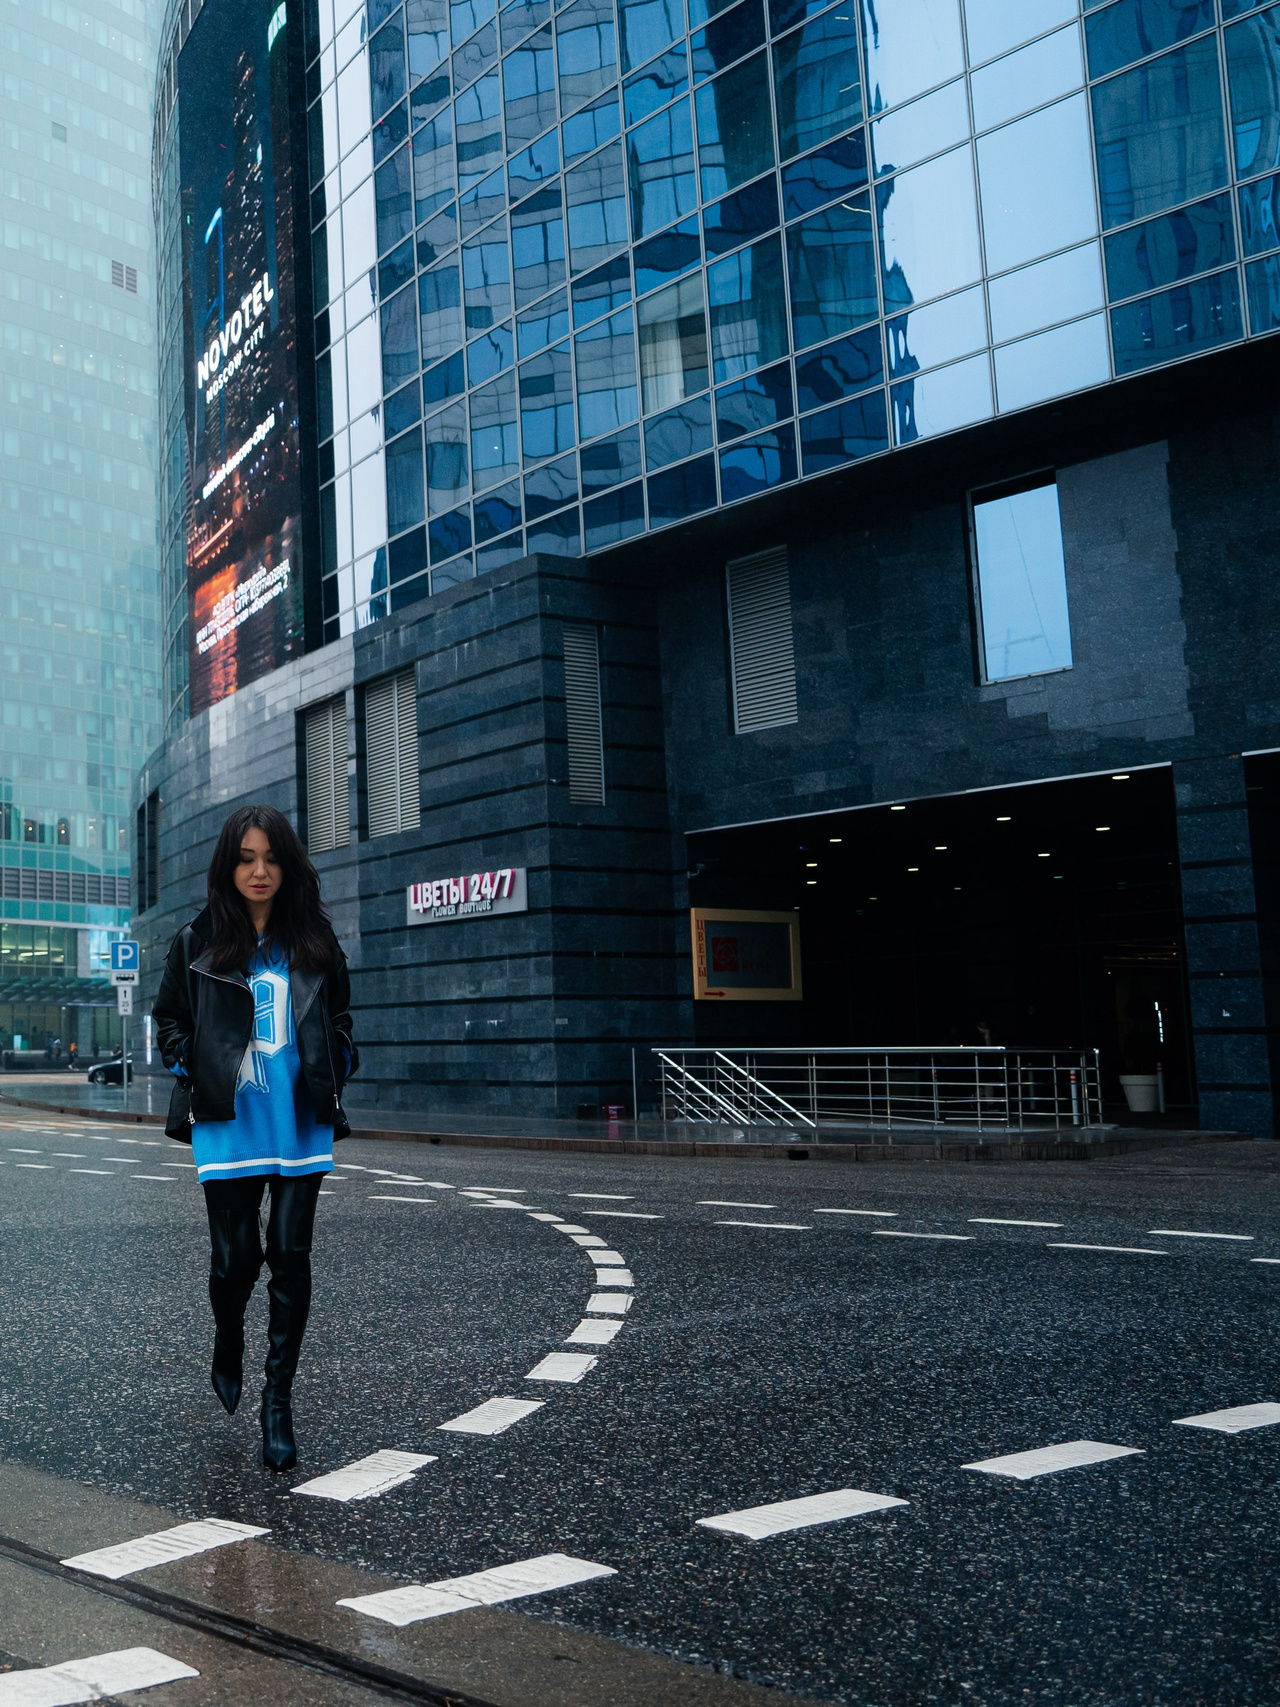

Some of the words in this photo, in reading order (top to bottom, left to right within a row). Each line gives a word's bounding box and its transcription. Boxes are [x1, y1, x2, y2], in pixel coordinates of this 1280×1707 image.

[197, 271, 274, 389] NOVOTEL
[206, 350, 243, 404] MOSCOW
[243, 322, 265, 356] CITY
[410, 876, 467, 913] ЦВЕТЫ
[470, 868, 515, 901] 24/7
[431, 904, 456, 918] FLOWER
[459, 899, 492, 914] BOUTIQUE
[117, 944, 134, 968] P
[696, 919, 708, 977] ЦВЕТЫ
